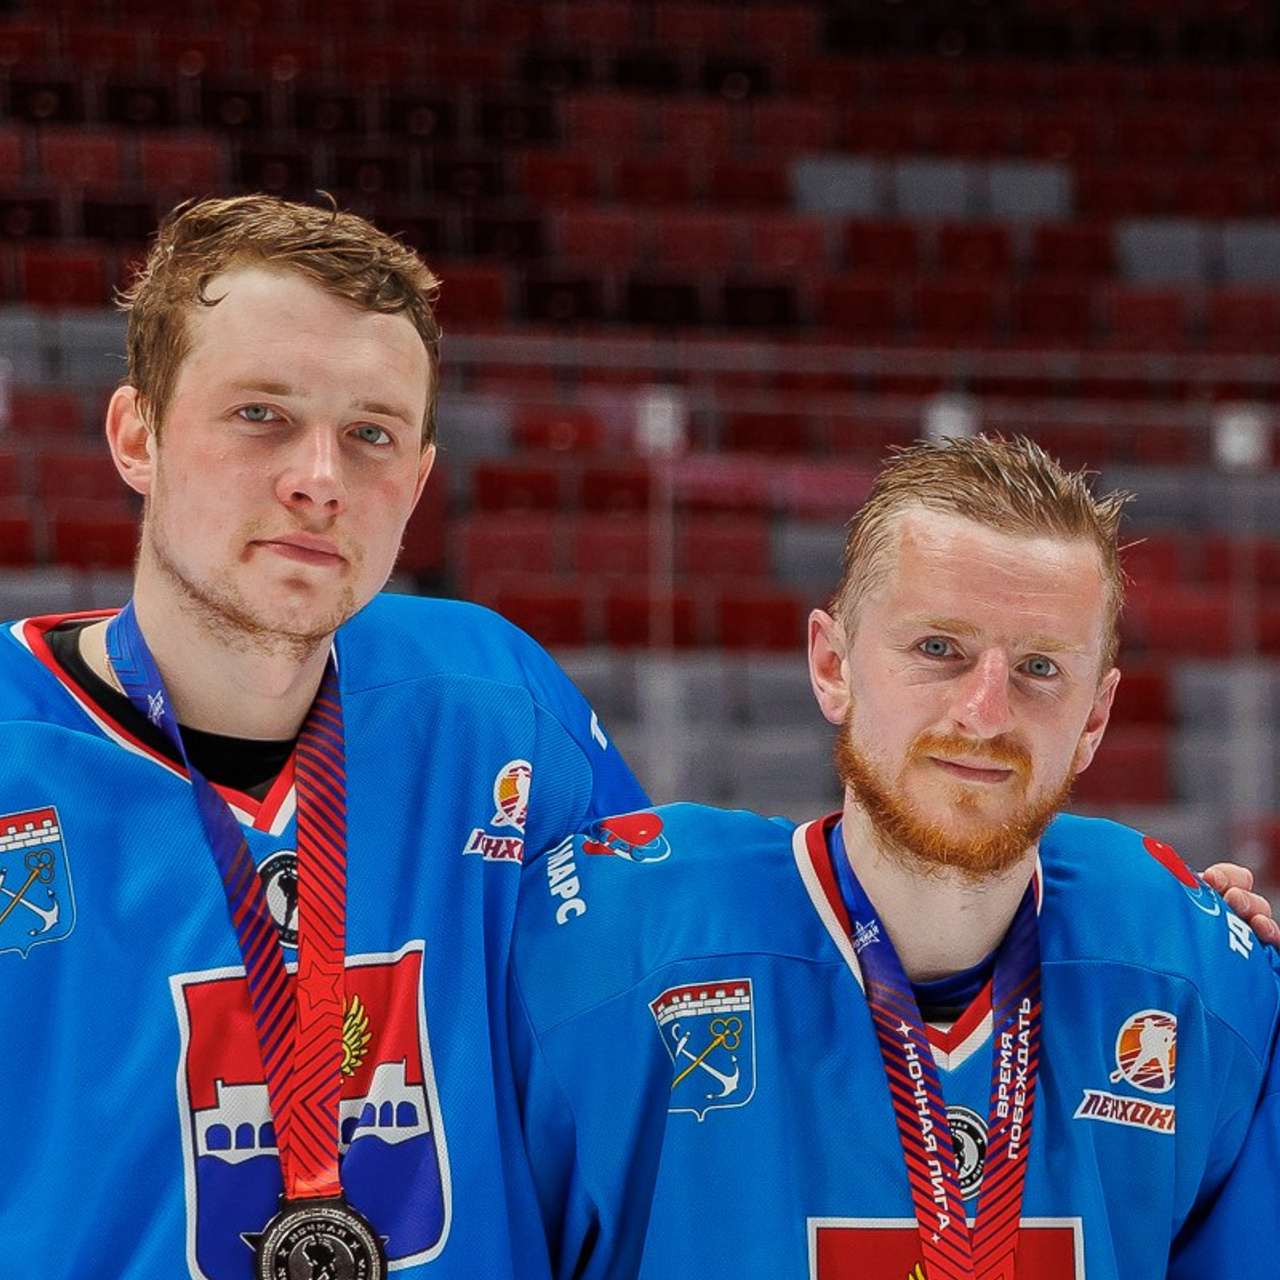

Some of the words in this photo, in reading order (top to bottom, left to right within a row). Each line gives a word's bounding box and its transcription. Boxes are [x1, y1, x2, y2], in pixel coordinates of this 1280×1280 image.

[903, 1042, 937, 1153] НОЧНАЯ
[928, 1160, 950, 1231] ЛИГА
[996, 1032, 1014, 1118] ВРЕМЯ
[1008, 998, 1032, 1159] ПОБЕЖДАТЬ
